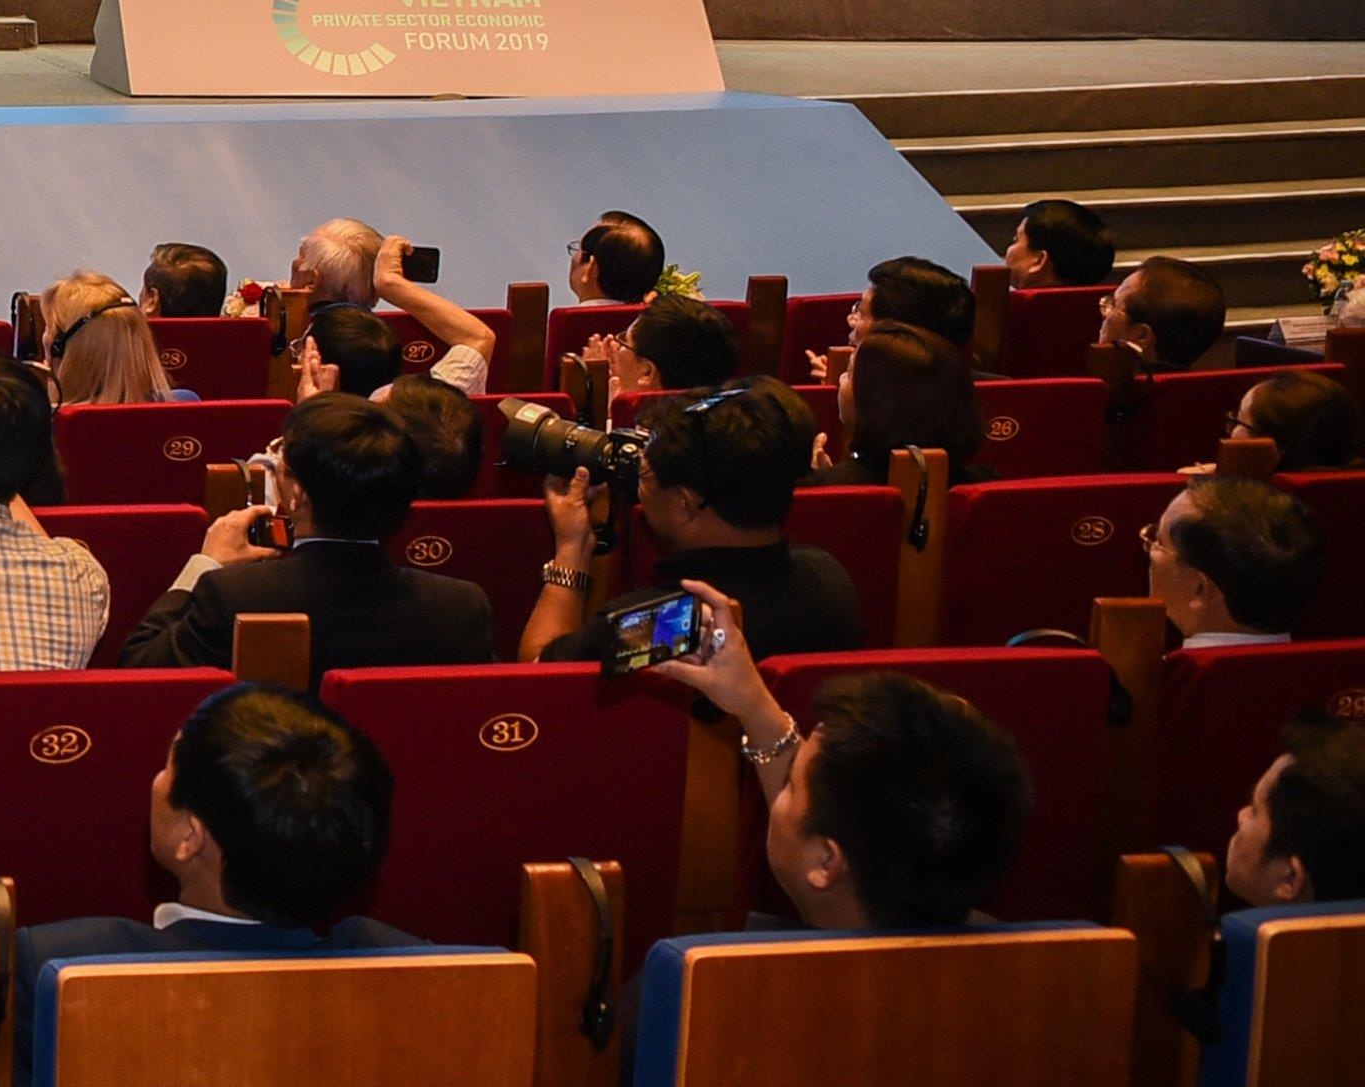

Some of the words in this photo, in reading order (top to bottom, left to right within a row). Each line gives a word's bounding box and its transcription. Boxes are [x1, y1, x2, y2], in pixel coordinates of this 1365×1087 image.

[311, 14, 382, 27] PRIVATE
[385, 14, 452, 27] SECTOR
[456, 14, 545, 28] ECONOMIC
[404, 31, 490, 51] FORUM
[496, 31, 549, 52] 2019
[407, 344, 428, 358] 27
[990, 420, 1012, 435] 26
[170, 439, 195, 455] 29
[414, 541, 446, 561] 30
[492, 721, 526, 744] 31
[42, 733, 79, 756] 32
